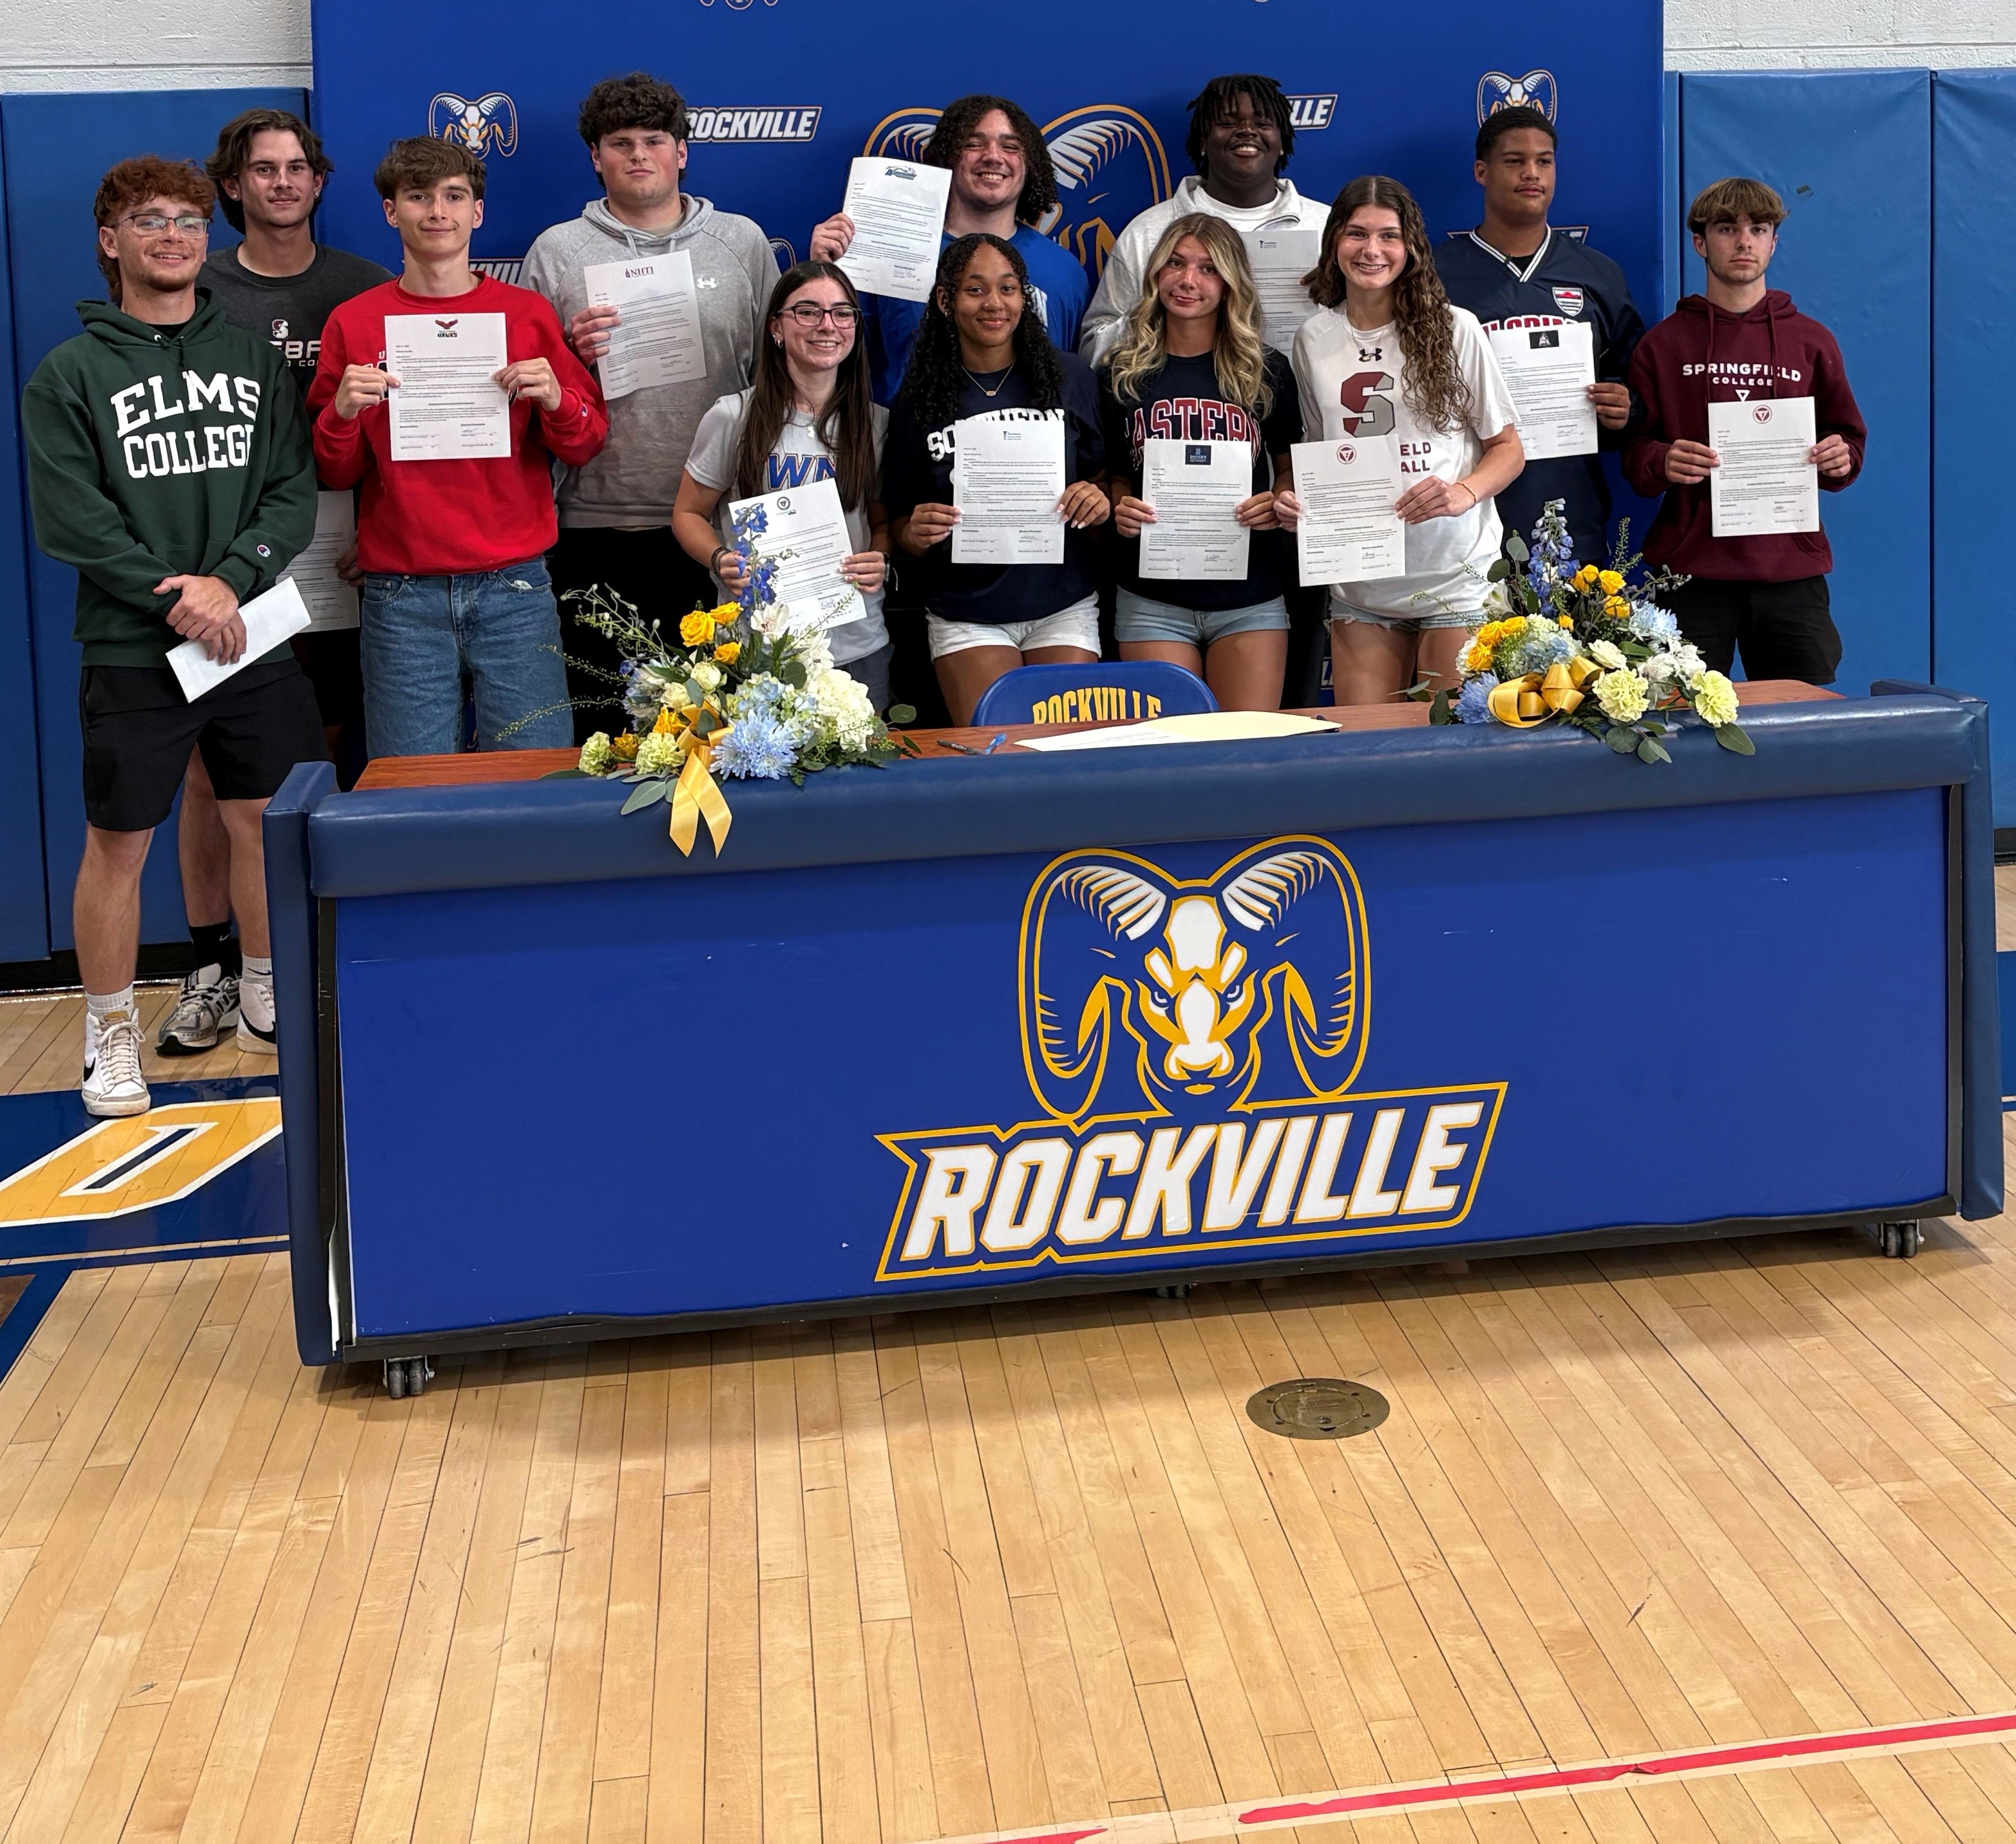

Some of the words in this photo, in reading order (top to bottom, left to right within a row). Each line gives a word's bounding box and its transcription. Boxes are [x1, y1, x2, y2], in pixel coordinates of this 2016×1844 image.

[685, 111, 816, 139] ROCKVILLE
[1289, 99, 1332, 126] LLE
[110, 370, 261, 438] ELMS
[1340, 371, 1395, 438] S
[1713, 377, 1773, 386] COLLEGE
[1125, 397, 1262, 471] ASTERN
[899, 1101, 1485, 1261] ROCKVILLE
